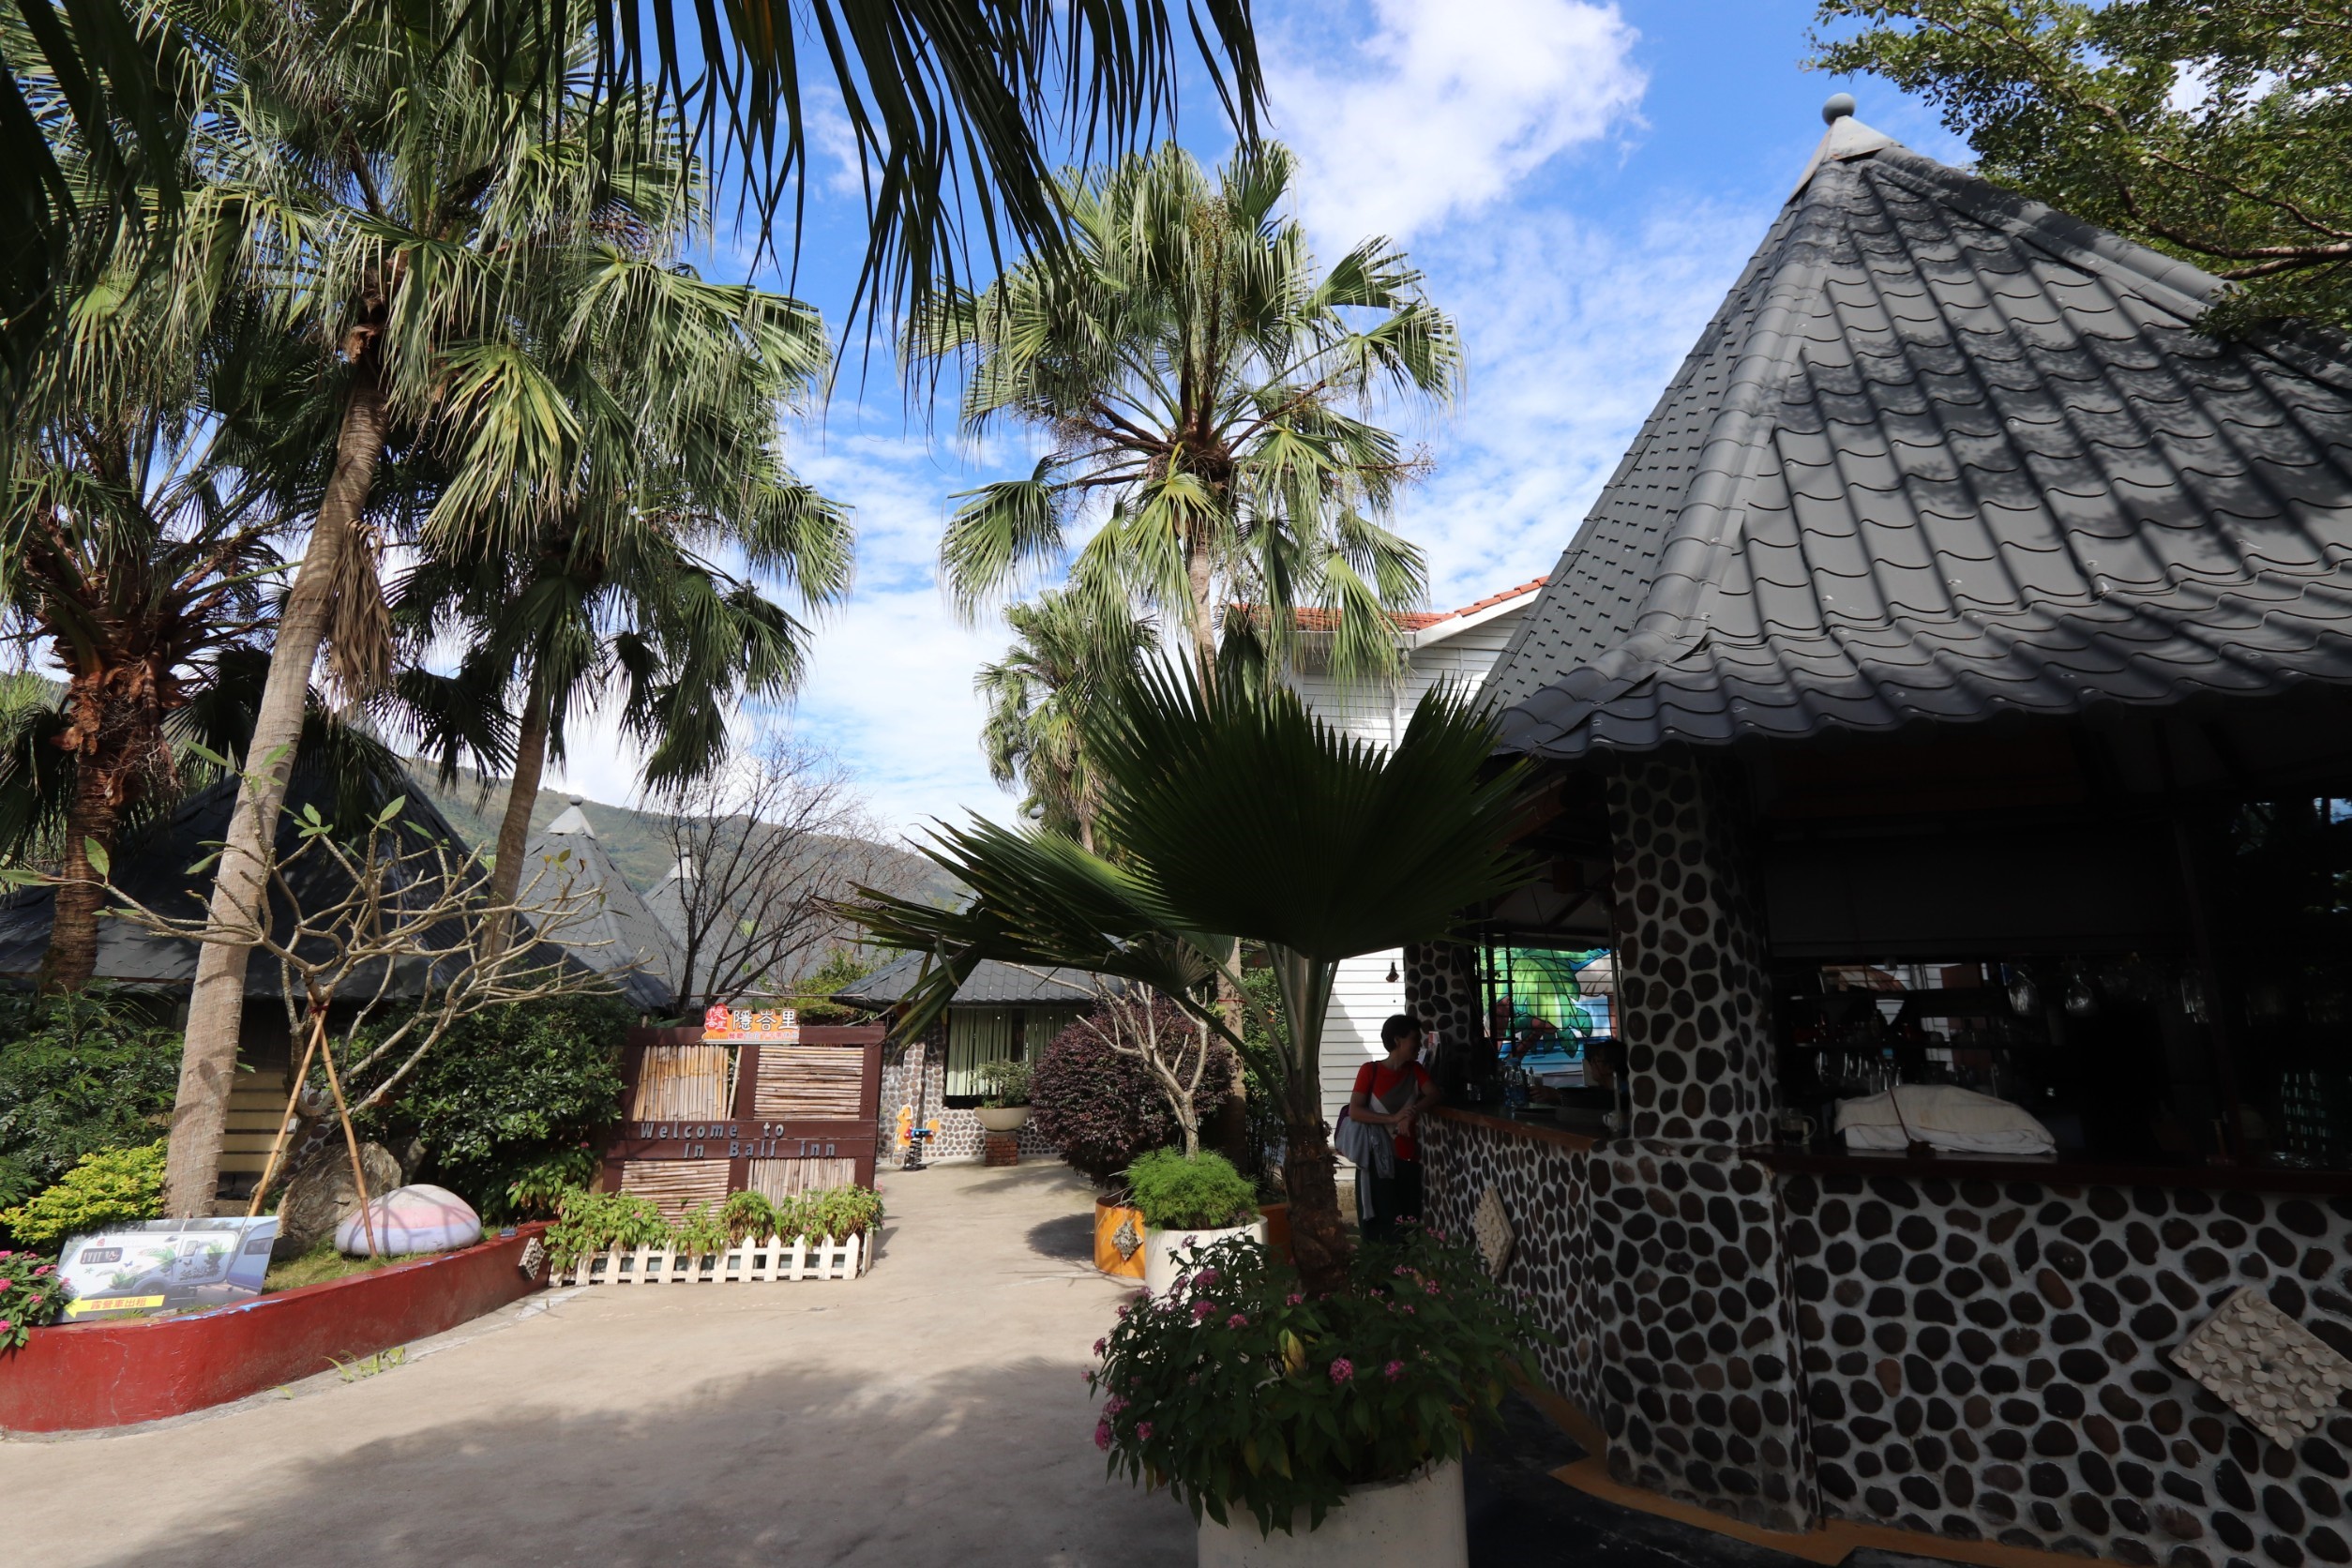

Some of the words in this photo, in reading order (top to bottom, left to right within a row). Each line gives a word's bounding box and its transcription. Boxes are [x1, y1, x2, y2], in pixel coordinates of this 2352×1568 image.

[732, 1009, 799, 1031] 隱峇里
[641, 1121, 738, 1139] Welcome
[763, 1122, 784, 1138] to
[729, 1140, 777, 1158] Bali
[800, 1139, 836, 1156] inn
[90, 1298, 147, 1310] 露營車出租
